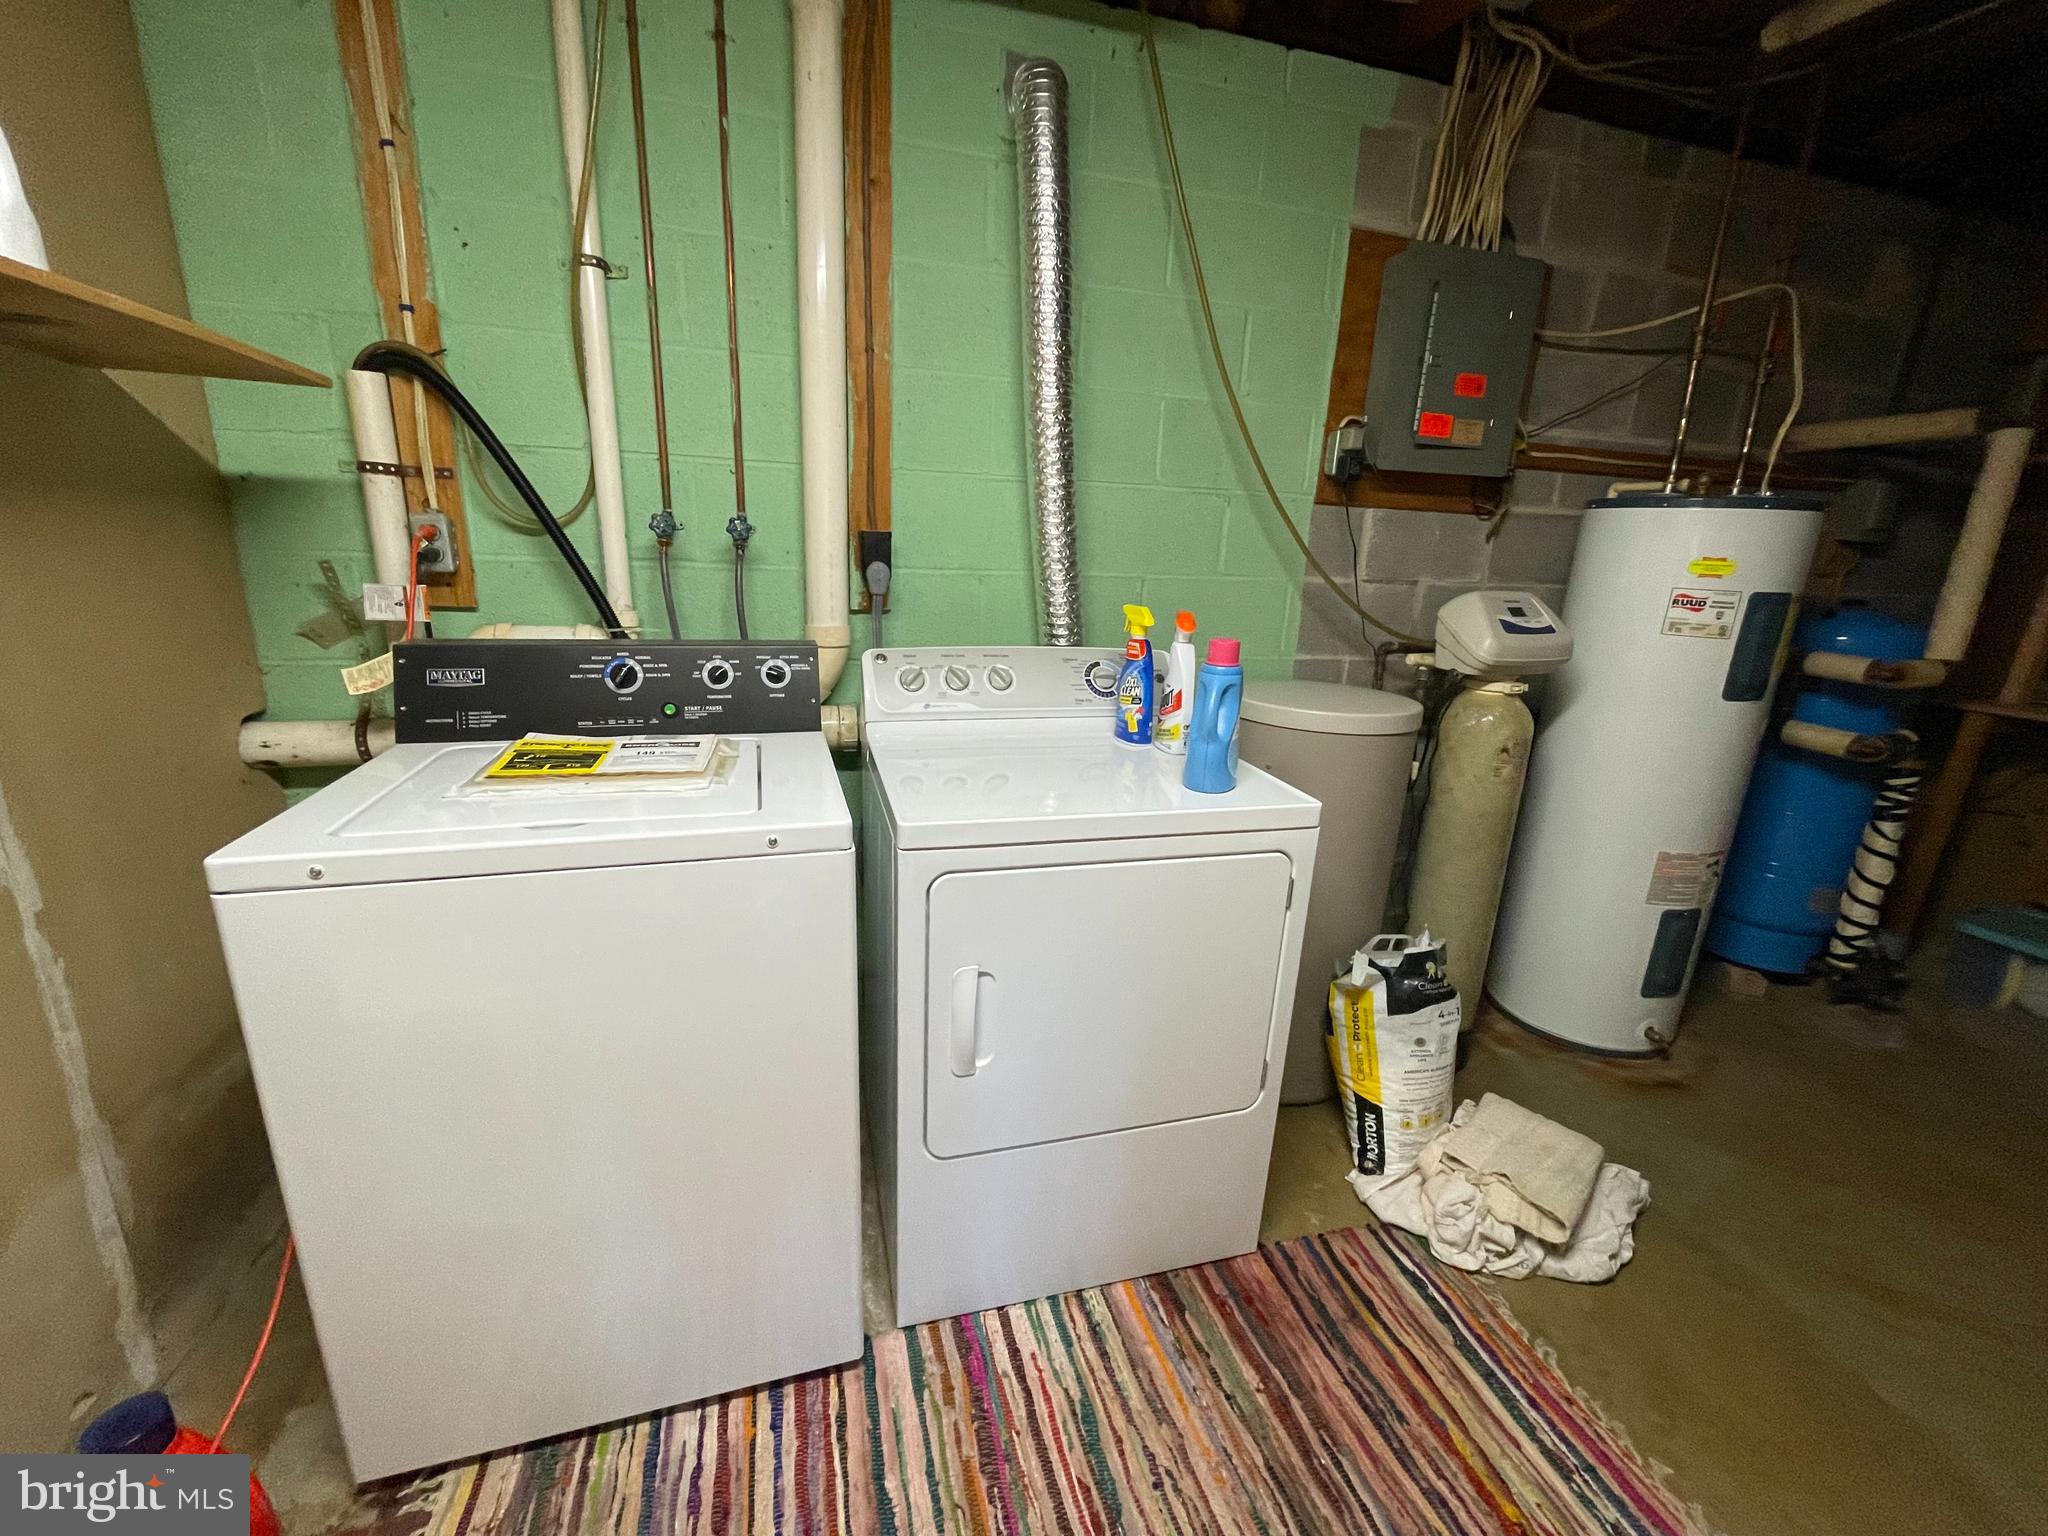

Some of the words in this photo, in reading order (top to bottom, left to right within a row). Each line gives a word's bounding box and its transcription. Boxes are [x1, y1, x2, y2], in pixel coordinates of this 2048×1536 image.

[1672, 598, 1707, 607] RUUD
[430, 670, 482, 680] MAYTAG
[1125, 676, 1137, 687] OXI
[1120, 685, 1141, 697] CLEAN
[1352, 998, 1361, 1042] Protect
[1356, 1052, 1366, 1082] Clean
[1364, 1112, 1378, 1162] MORTON
